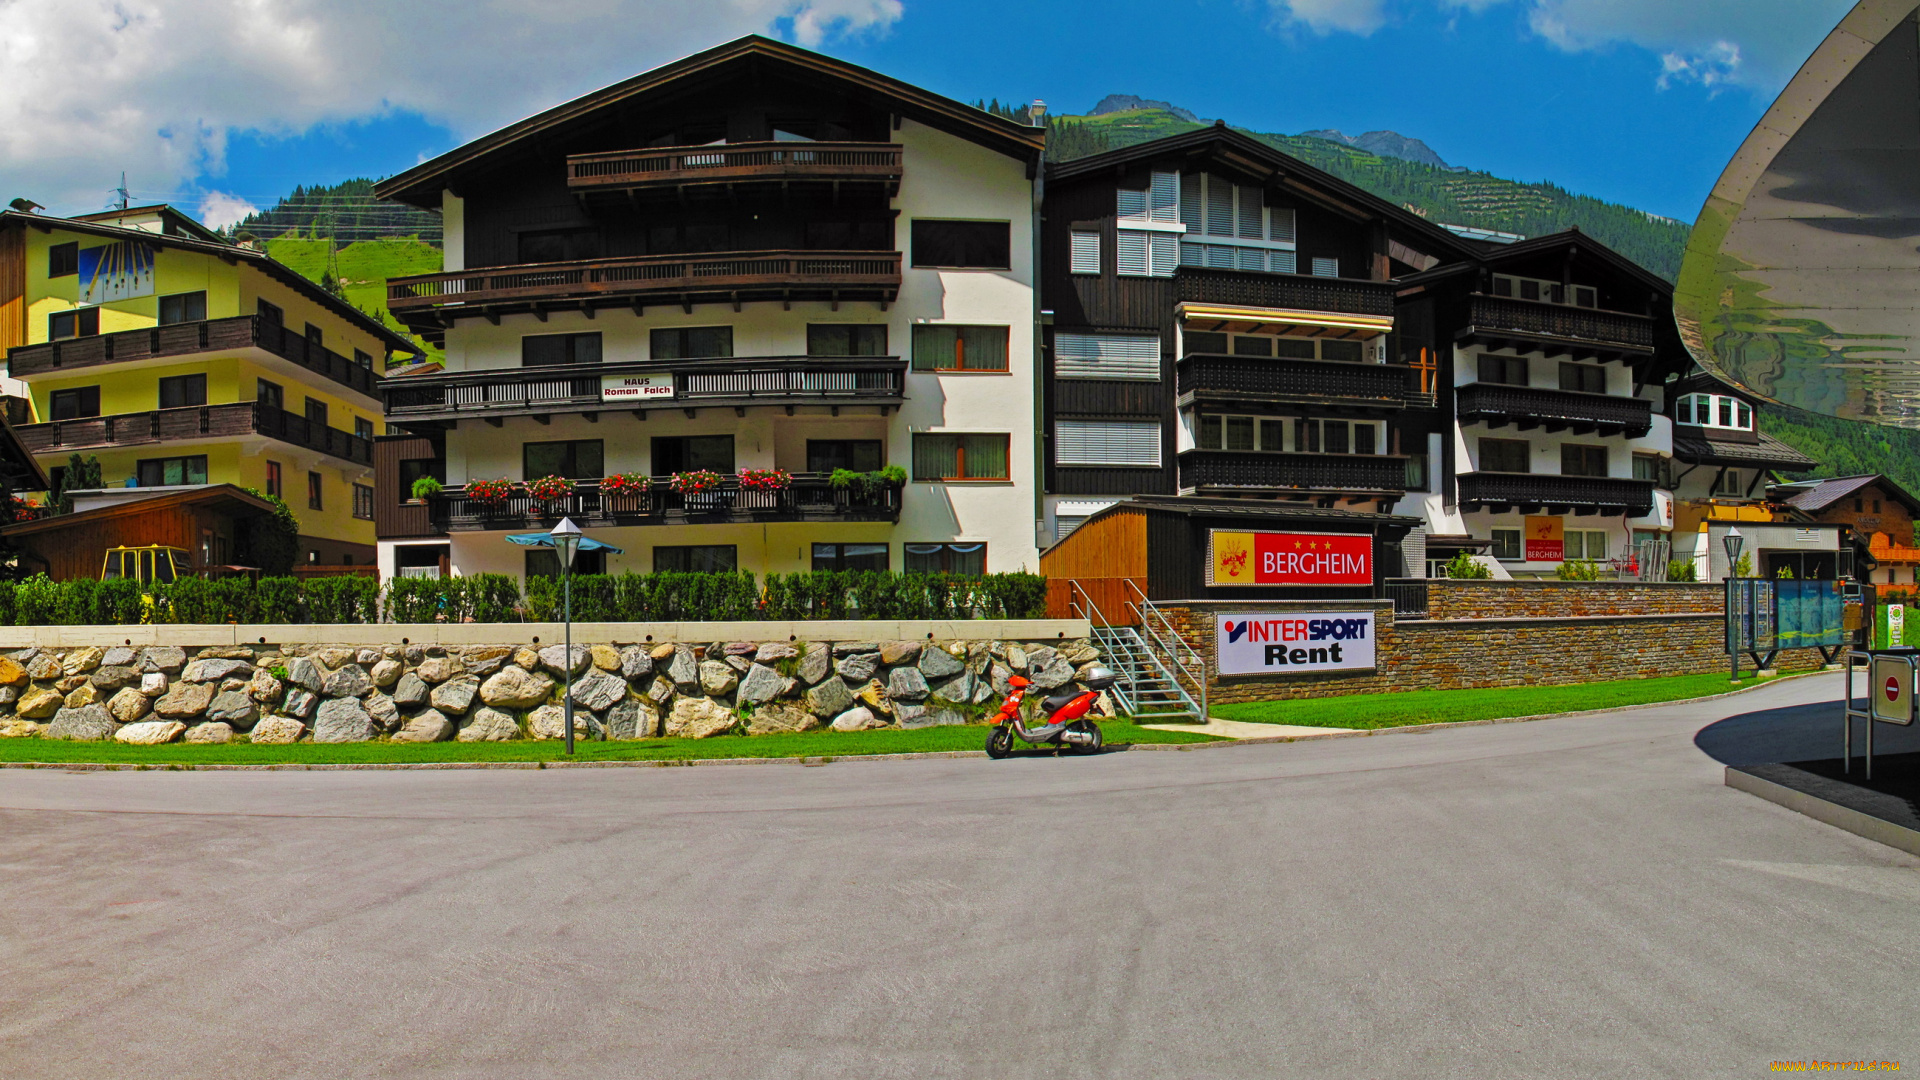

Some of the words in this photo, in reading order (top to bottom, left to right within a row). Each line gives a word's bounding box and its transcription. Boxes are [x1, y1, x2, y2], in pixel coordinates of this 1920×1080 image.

[624, 378, 650, 386] HAUS
[604, 388, 638, 396] Roman
[644, 386, 671, 394] Falch
[1527, 550, 1562, 559] BERGHEIM
[1263, 552, 1365, 574] BERGHEIM
[1248, 618, 1368, 642] INTERSPORT
[1264, 642, 1343, 666] Rent
